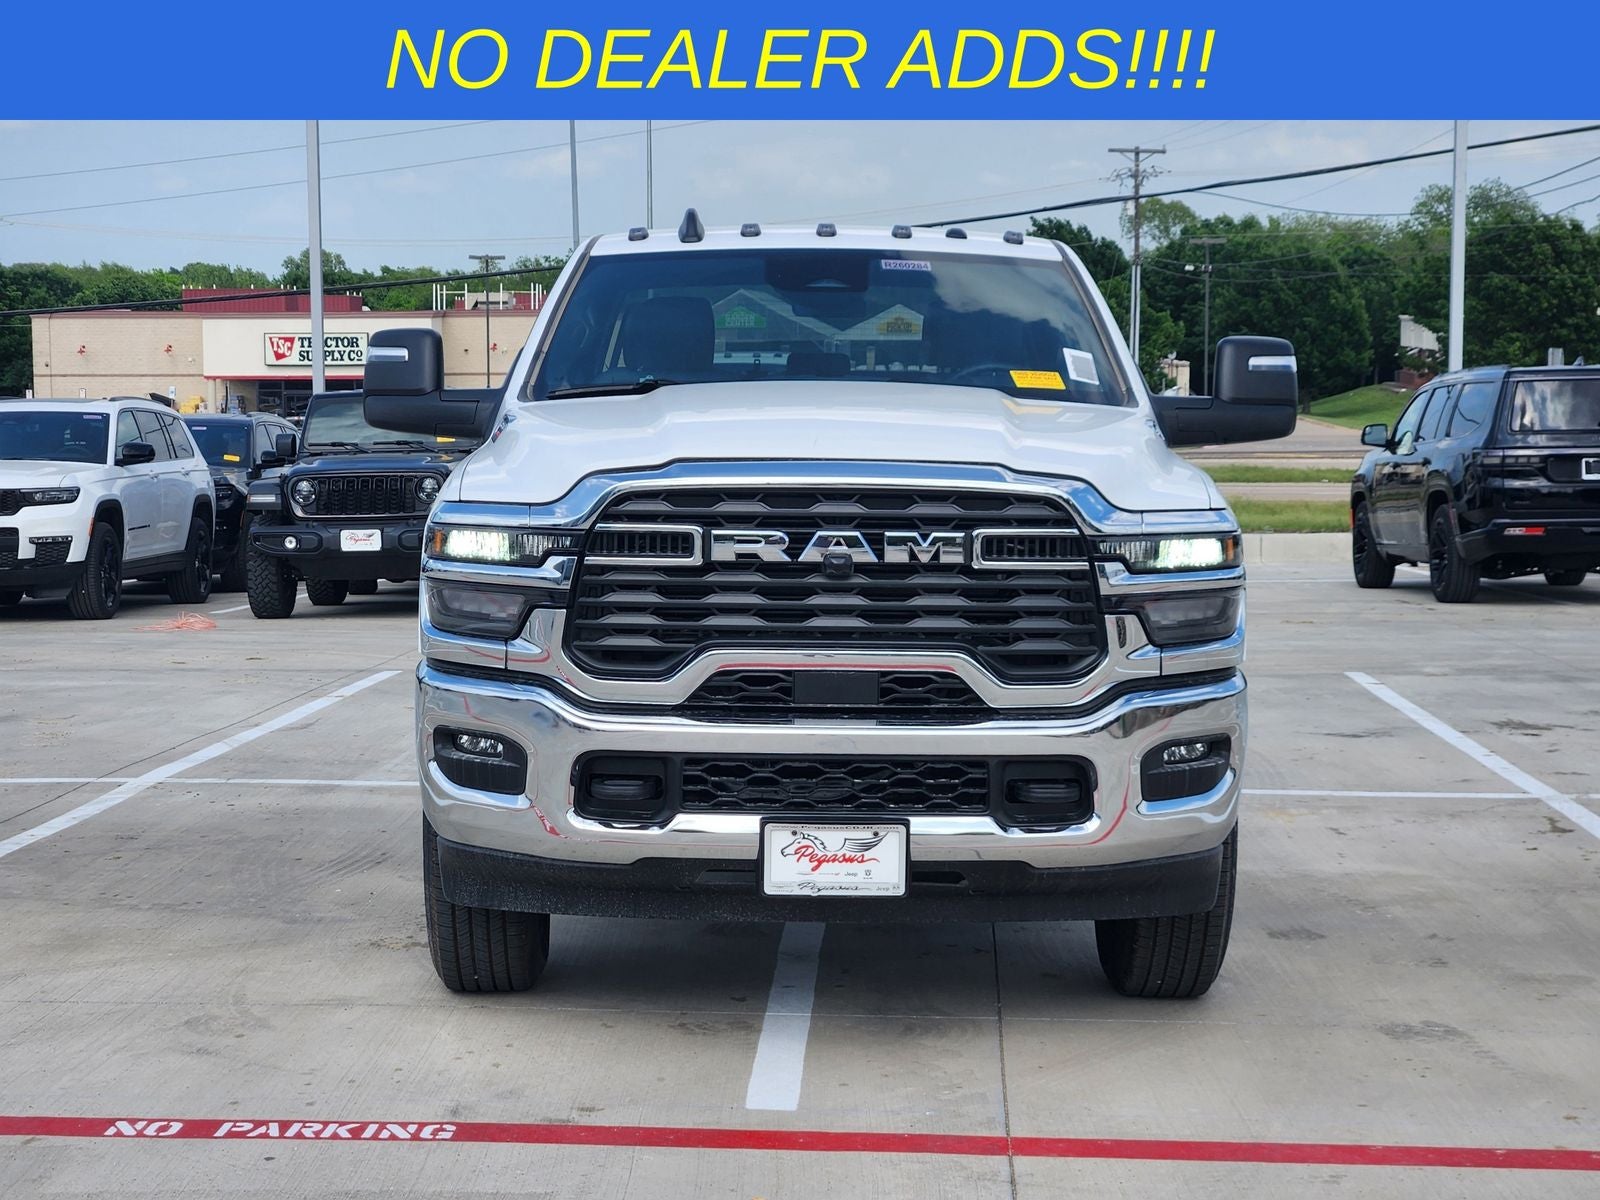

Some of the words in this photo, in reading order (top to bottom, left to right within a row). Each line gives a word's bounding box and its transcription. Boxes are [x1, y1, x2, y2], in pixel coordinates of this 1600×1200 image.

[271, 337, 292, 356] TSC
[298, 336, 360, 348] TRCTOR
[298, 350, 346, 361] SUPLY
[710, 530, 966, 563] RAM
[794, 845, 872, 872] Pegasus
[104, 1120, 184, 1137] NO
[213, 1121, 457, 1140] PARKING
